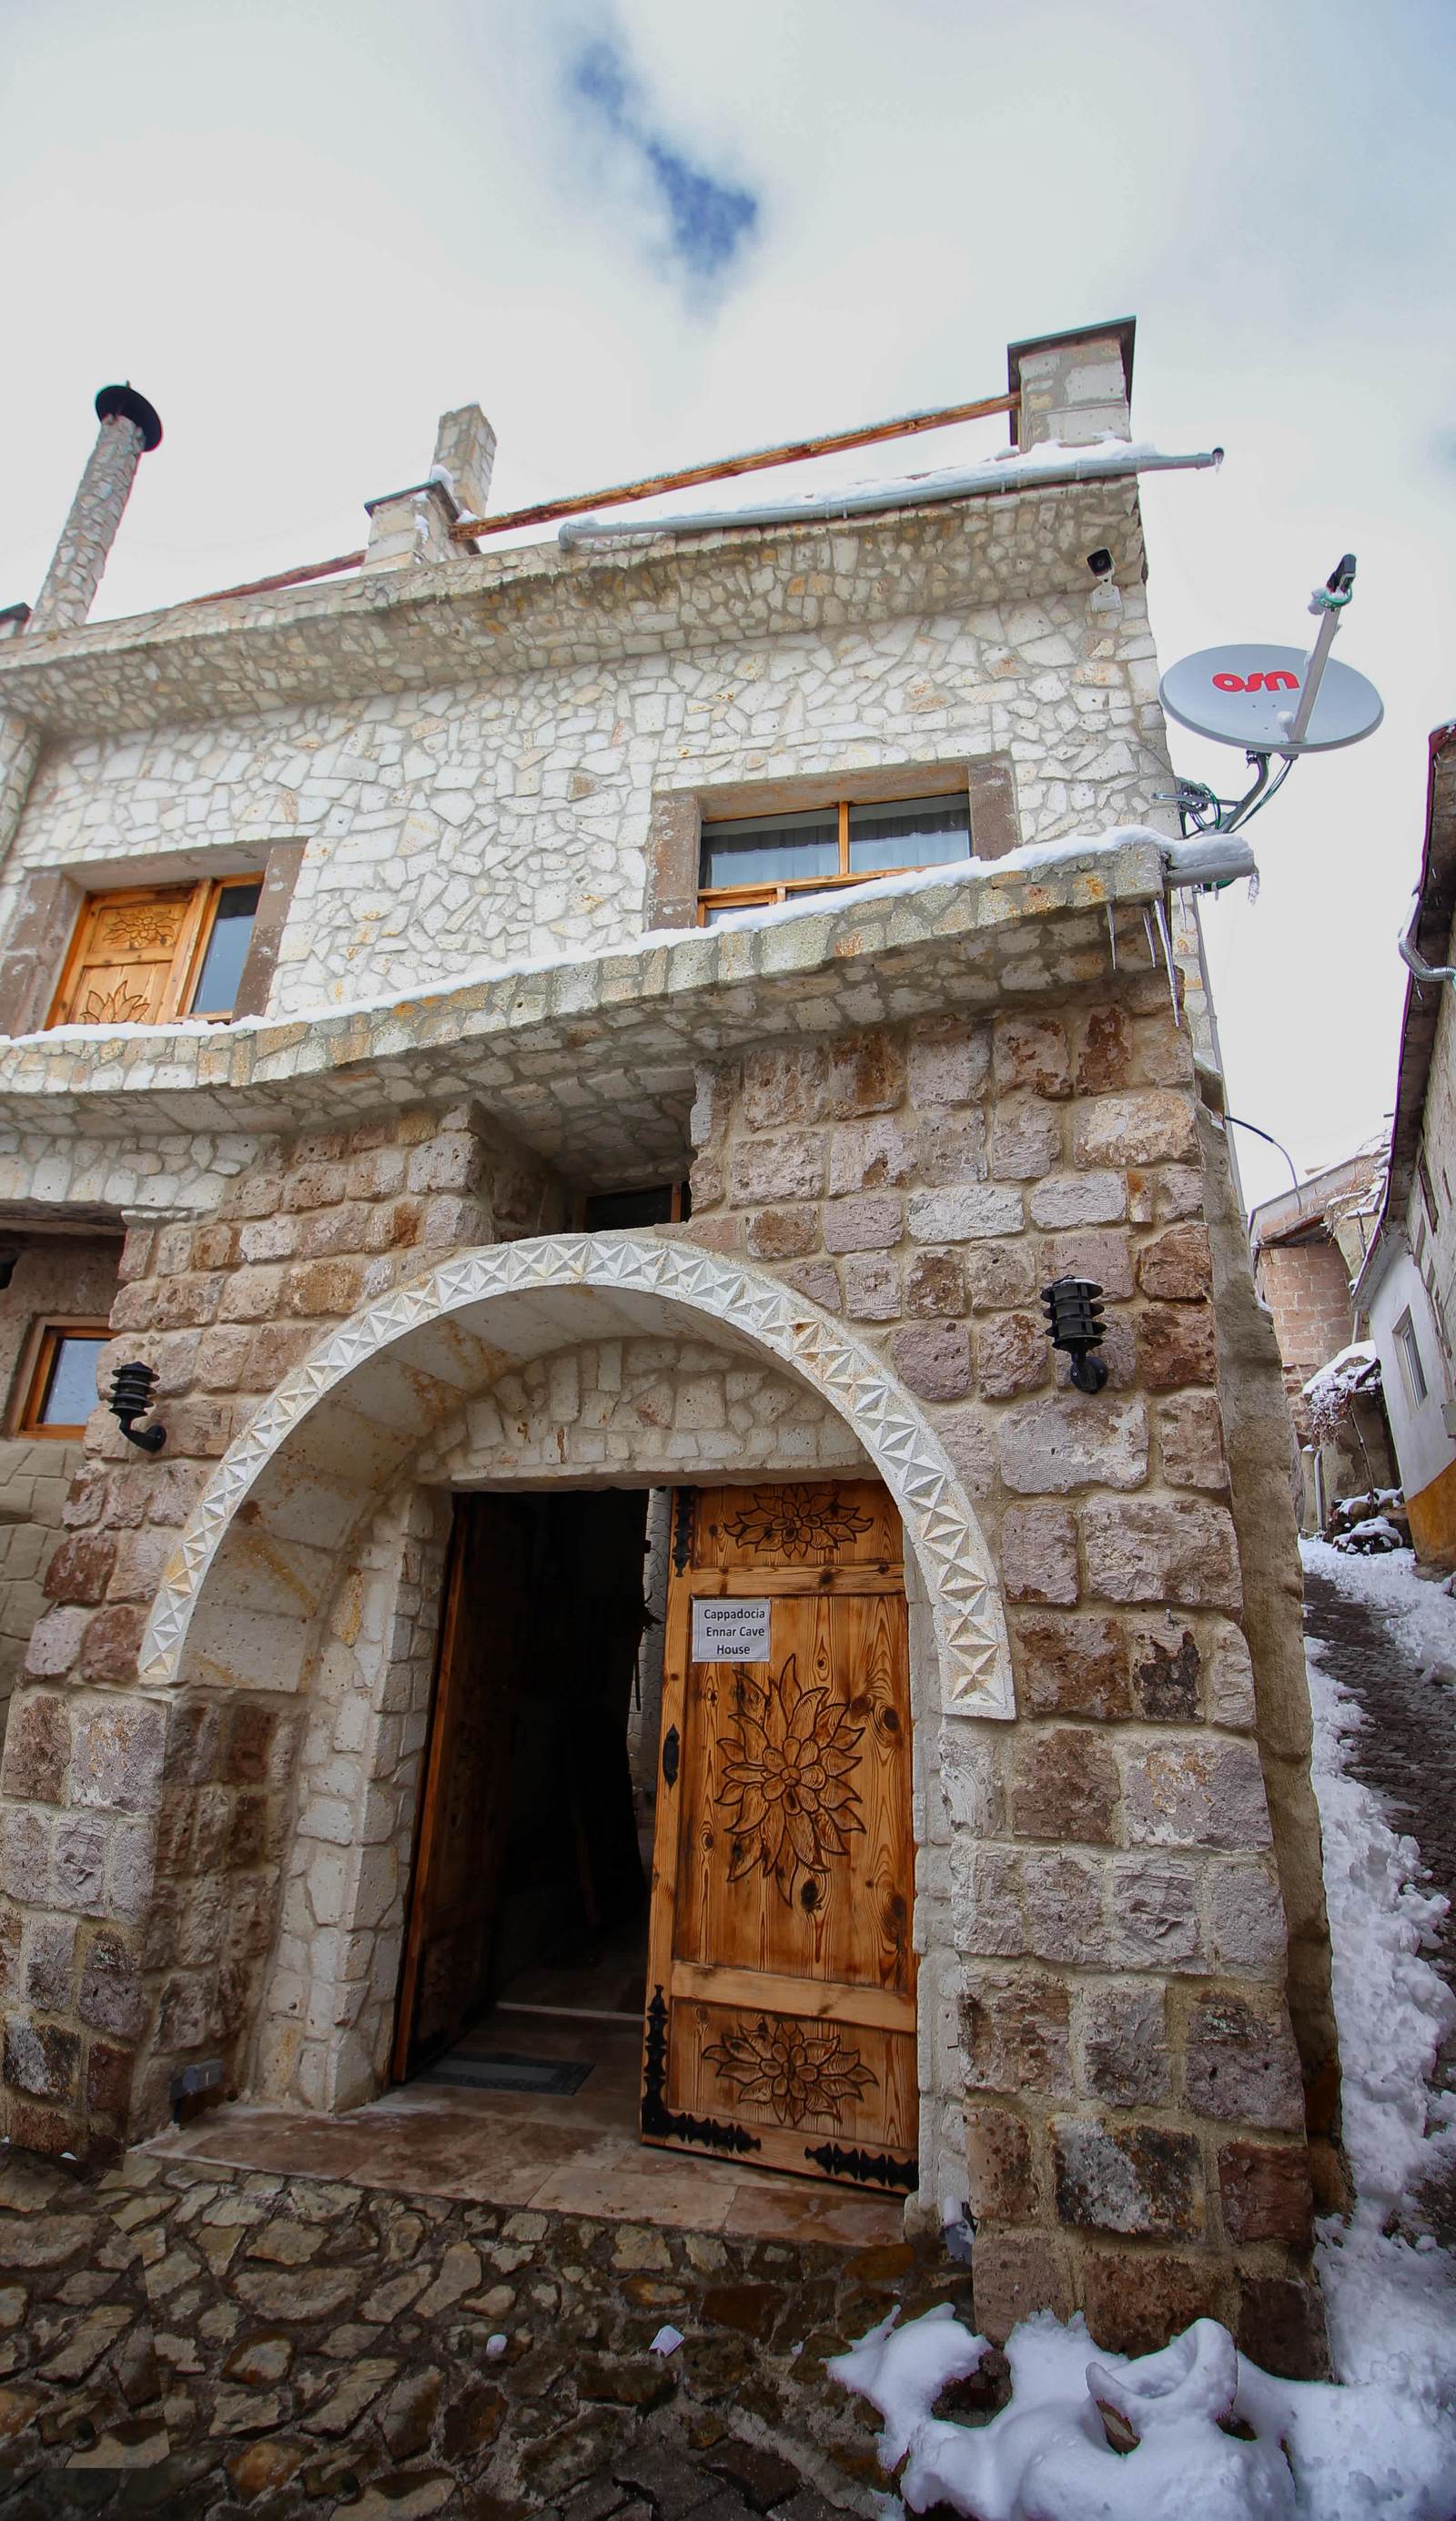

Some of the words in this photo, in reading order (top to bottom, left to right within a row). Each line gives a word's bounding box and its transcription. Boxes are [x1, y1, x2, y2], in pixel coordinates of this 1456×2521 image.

[704, 1608, 765, 1622] Cappadocia
[706, 1626, 737, 1637] Ennar
[739, 1625, 765, 1637] Cave
[716, 1644, 751, 1655] House
